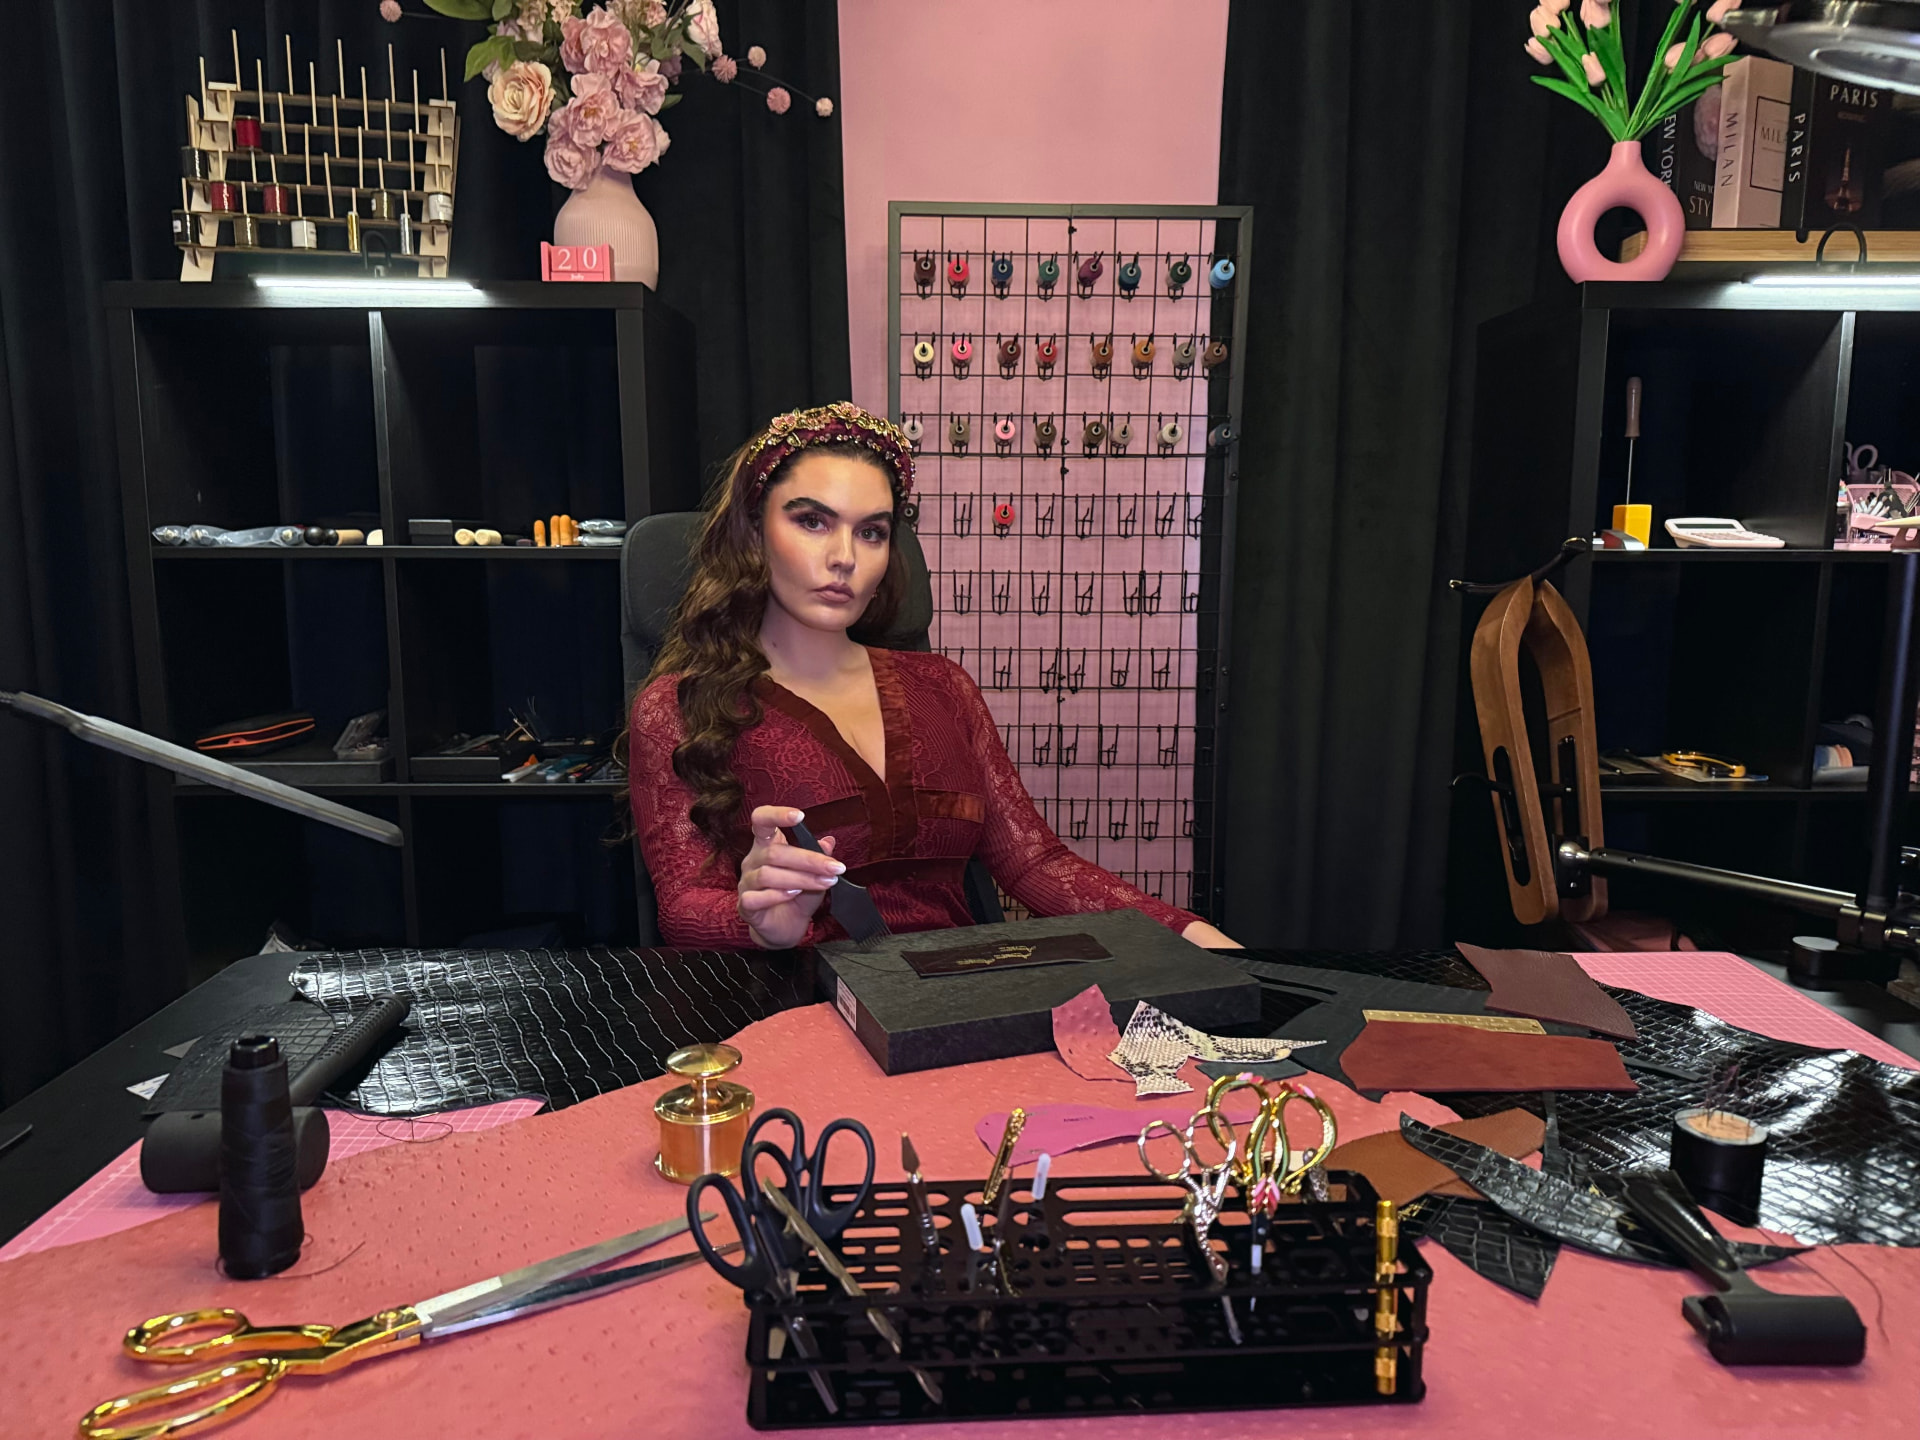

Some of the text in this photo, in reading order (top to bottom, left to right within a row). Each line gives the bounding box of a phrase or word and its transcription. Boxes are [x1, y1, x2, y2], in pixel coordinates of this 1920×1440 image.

[1830, 84, 1879, 108] PARIS
[1664, 113, 1677, 139] EW
[1761, 125, 1785, 144] MIL
[1721, 112, 1738, 187] MILAN
[1789, 113, 1806, 183] PARIS
[1690, 195, 1711, 217] STY
